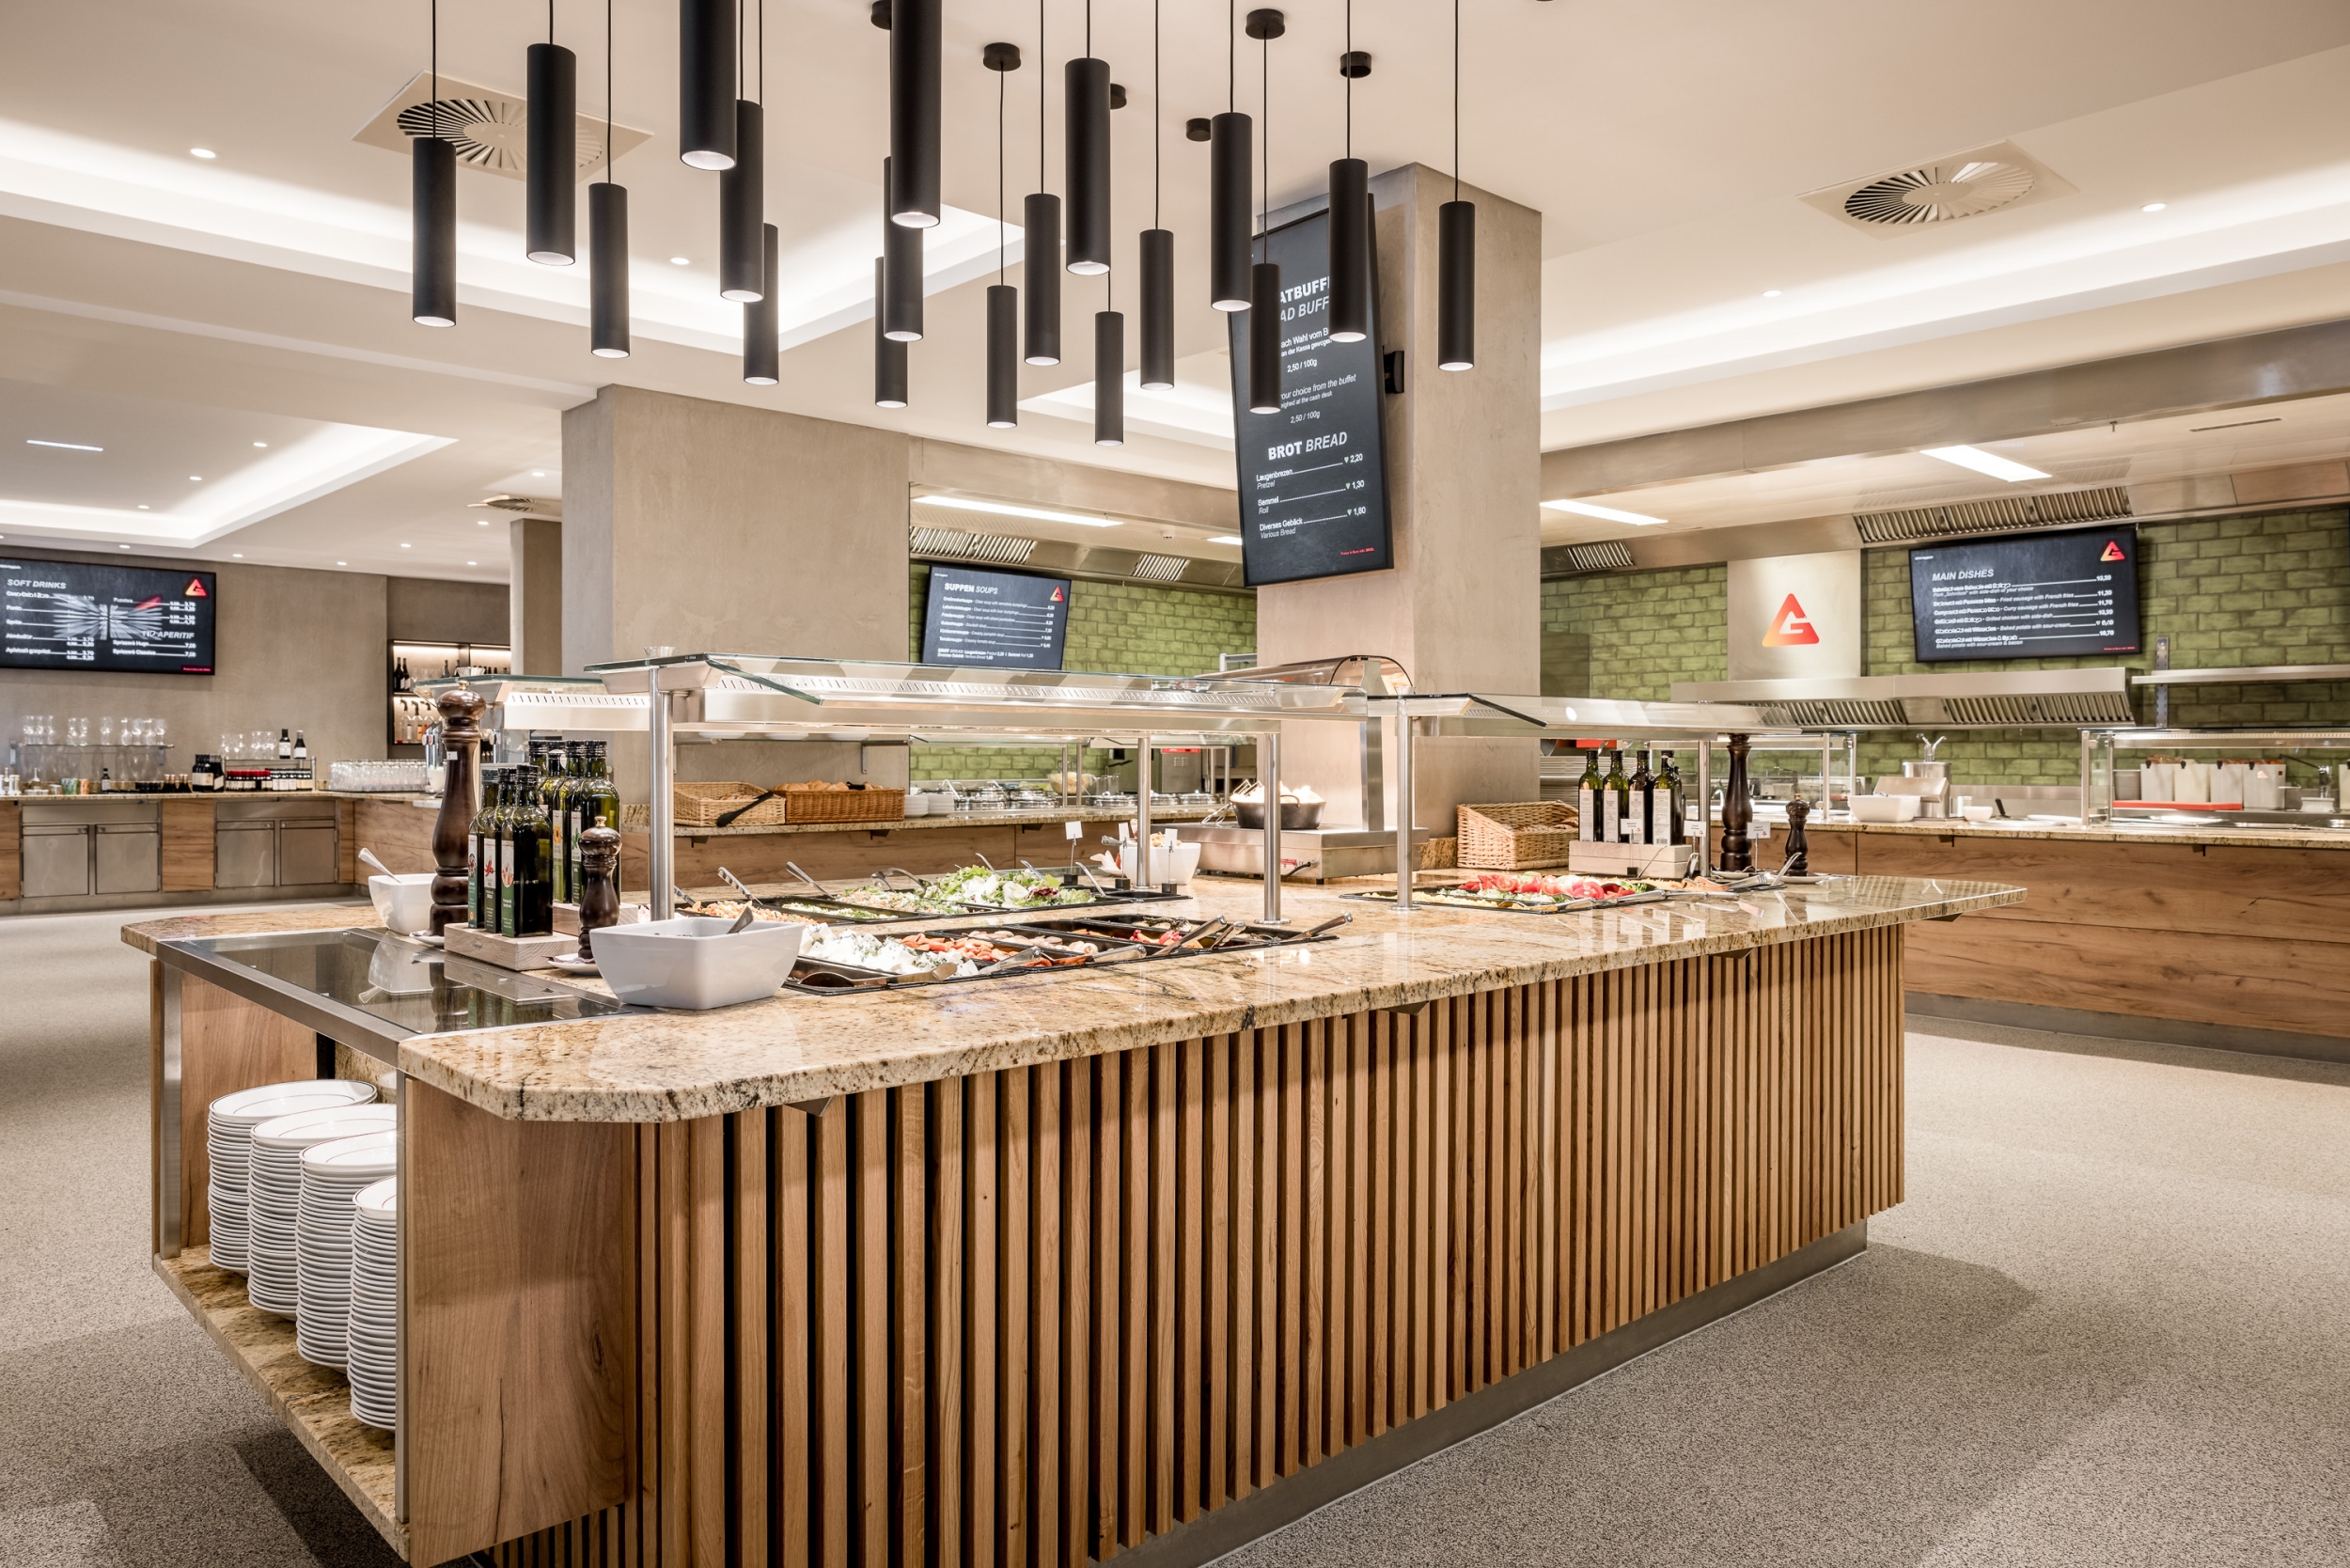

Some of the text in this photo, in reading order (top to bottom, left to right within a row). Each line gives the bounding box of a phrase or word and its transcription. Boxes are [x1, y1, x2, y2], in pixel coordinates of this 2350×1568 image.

[1280, 275, 1329, 304] ATBUFF
[1280, 295, 1329, 321] AD BUFF
[1281, 338, 1292, 349] ach
[1292, 333, 1308, 345] Wahl
[1308, 330, 1323, 340] vom
[1296, 344, 1310, 353] Kassa
[1287, 362, 1299, 373] 2,50
[1304, 358, 1318, 368] 100g
[1280, 373, 1356, 400] our choice from the buffet
[1322, 390, 1333, 399] desk
[1290, 414, 1303, 424] 2,50
[1307, 411, 1321, 419] 100g
[1268, 431, 1348, 461] BROT BREAD
[1350, 453, 1363, 463] 2,20
[1257, 480, 1276, 490] Pretzel
[1258, 480, 1365, 507] Semmel 1,30
[1260, 522, 1281, 531] Diverses
[1282, 517, 1303, 527] Gebäck
[1261, 527, 1296, 540] Various Bread
[1932, 569, 1994, 581] MAIN DISHES
[33, 581, 67, 589] DRINKS
[945, 583, 998, 594] SUPPEN SOUPS
